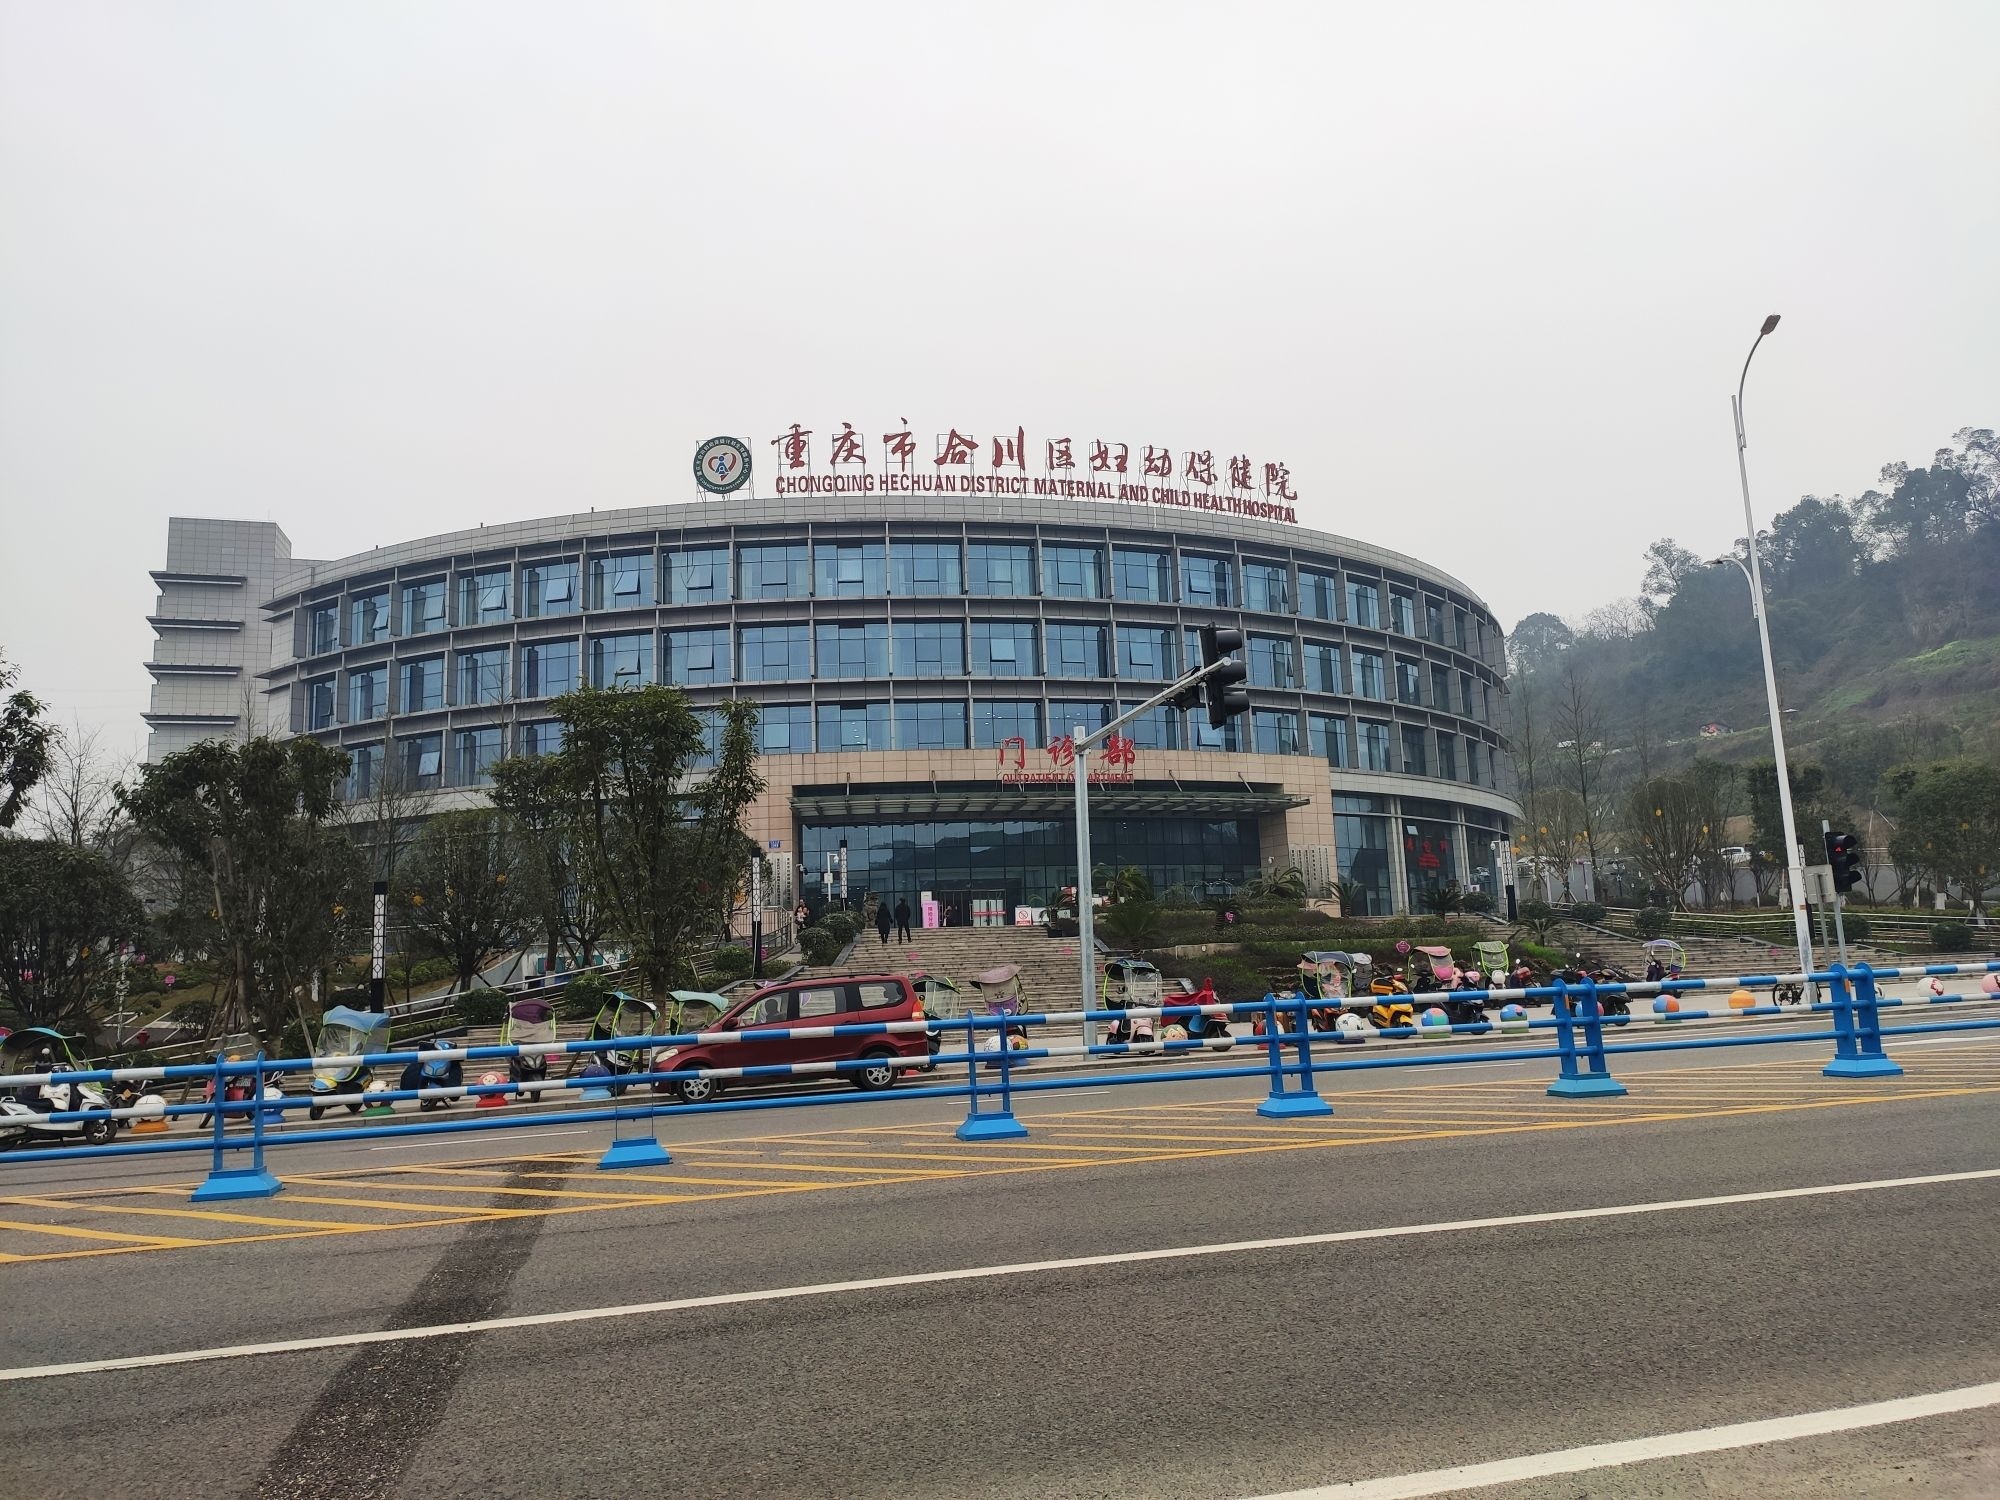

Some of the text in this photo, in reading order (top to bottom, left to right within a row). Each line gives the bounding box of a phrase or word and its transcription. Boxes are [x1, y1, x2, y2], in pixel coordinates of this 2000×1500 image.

[771, 417, 1298, 500] 重庆市合川区妇幼保健院
[775, 473, 1299, 524] CHONGQING HECHUAN DISTRICT MATERNAL AND CHILD HEALTH HOSPITAL
[999, 734, 1136, 773] 门诊部
[1066, 772, 1134, 784] DARTMENT
